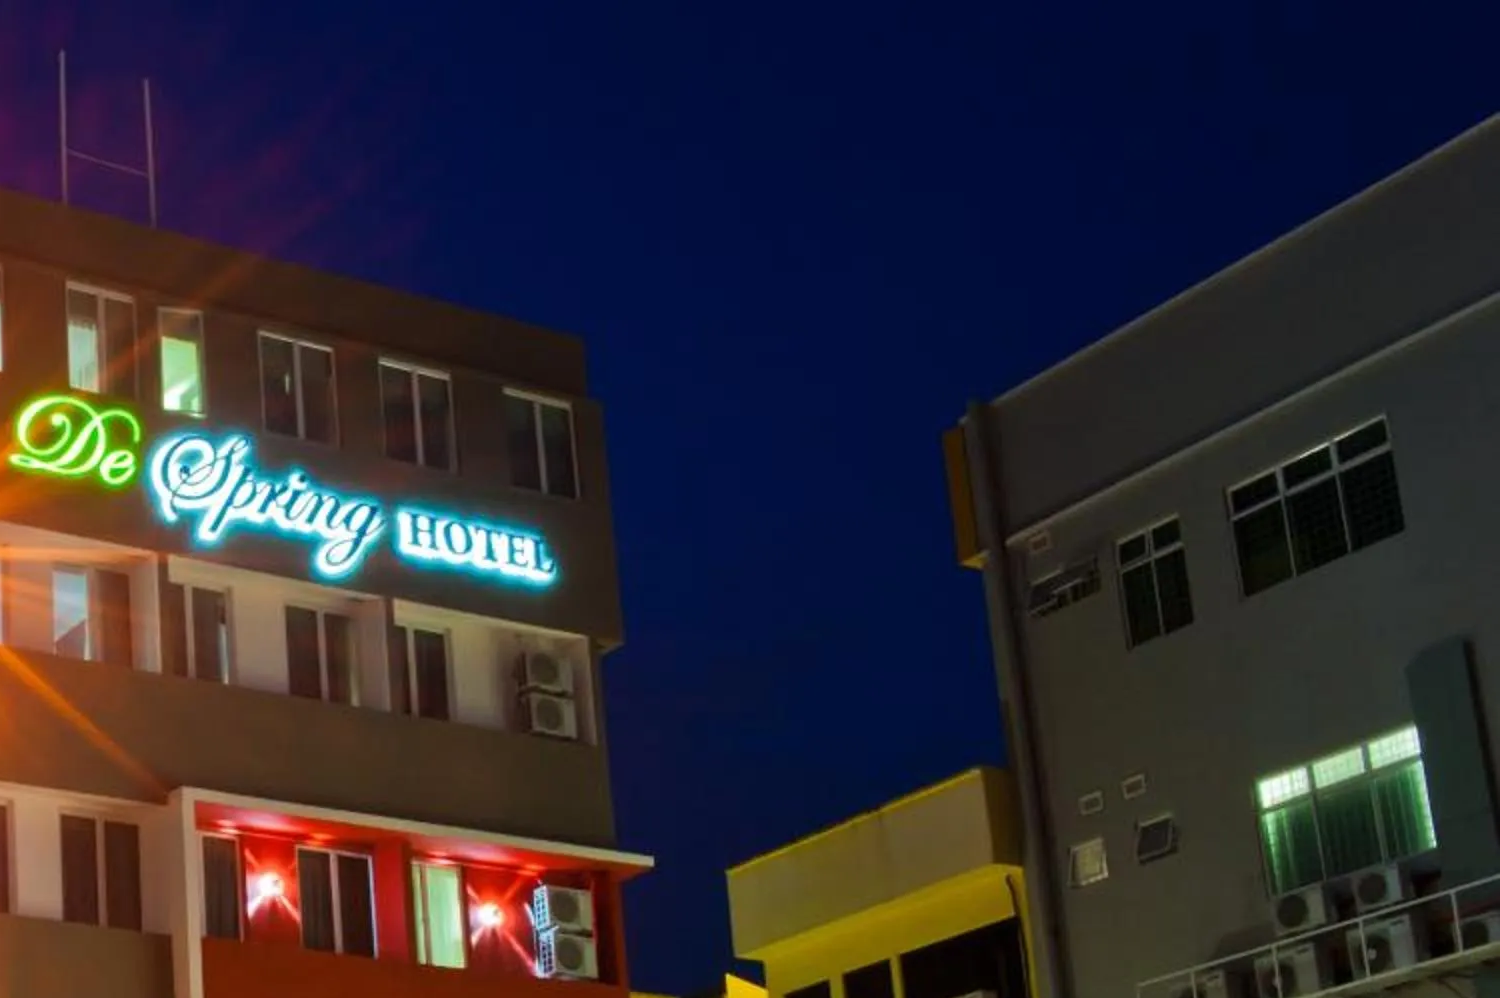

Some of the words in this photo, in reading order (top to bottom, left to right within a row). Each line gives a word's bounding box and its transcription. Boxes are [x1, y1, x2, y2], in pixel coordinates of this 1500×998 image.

[9, 395, 141, 485] De
[155, 432, 388, 573] Spring
[402, 510, 557, 579] HOTEL
